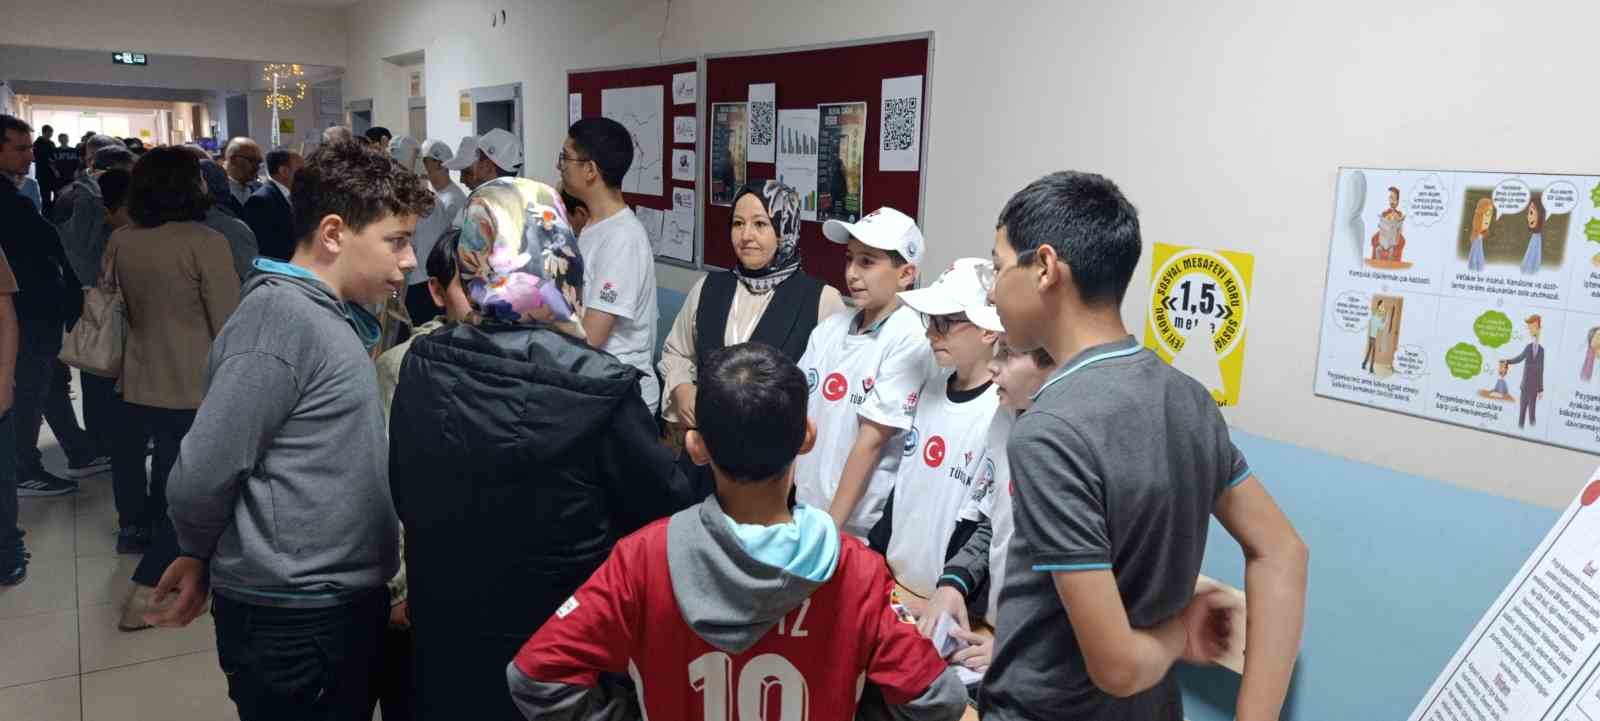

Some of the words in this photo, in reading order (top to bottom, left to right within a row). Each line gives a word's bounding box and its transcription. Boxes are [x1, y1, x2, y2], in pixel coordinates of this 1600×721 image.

[1157, 263, 1183, 295] SOSYAL
[1224, 278, 1240, 307] KORU
[1181, 280, 1216, 315] 1,5
[1155, 307, 1170, 335] KORU
